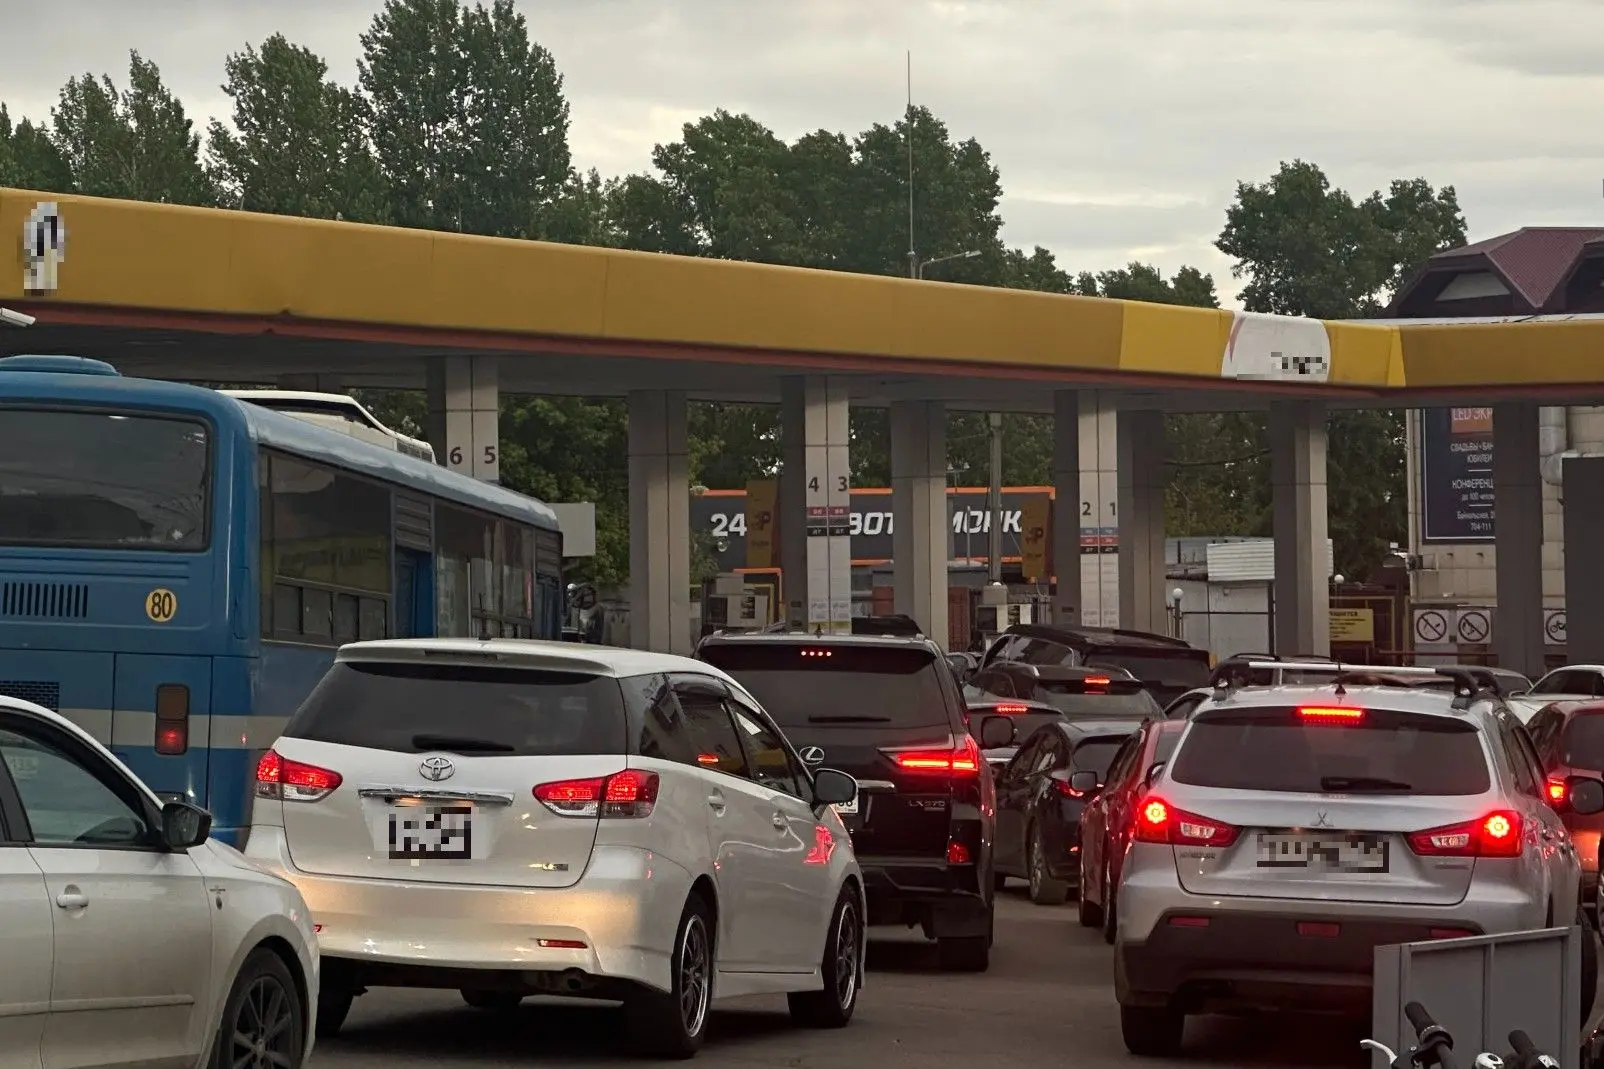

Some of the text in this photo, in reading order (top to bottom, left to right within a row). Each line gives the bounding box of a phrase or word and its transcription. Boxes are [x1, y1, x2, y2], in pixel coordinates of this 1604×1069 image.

[450, 446, 496, 465] 6 5
[808, 476, 848, 492] 4 3
[1082, 502, 1116, 516] 2 1
[710, 513, 747, 537] 24
[151, 592, 172, 618] 80
